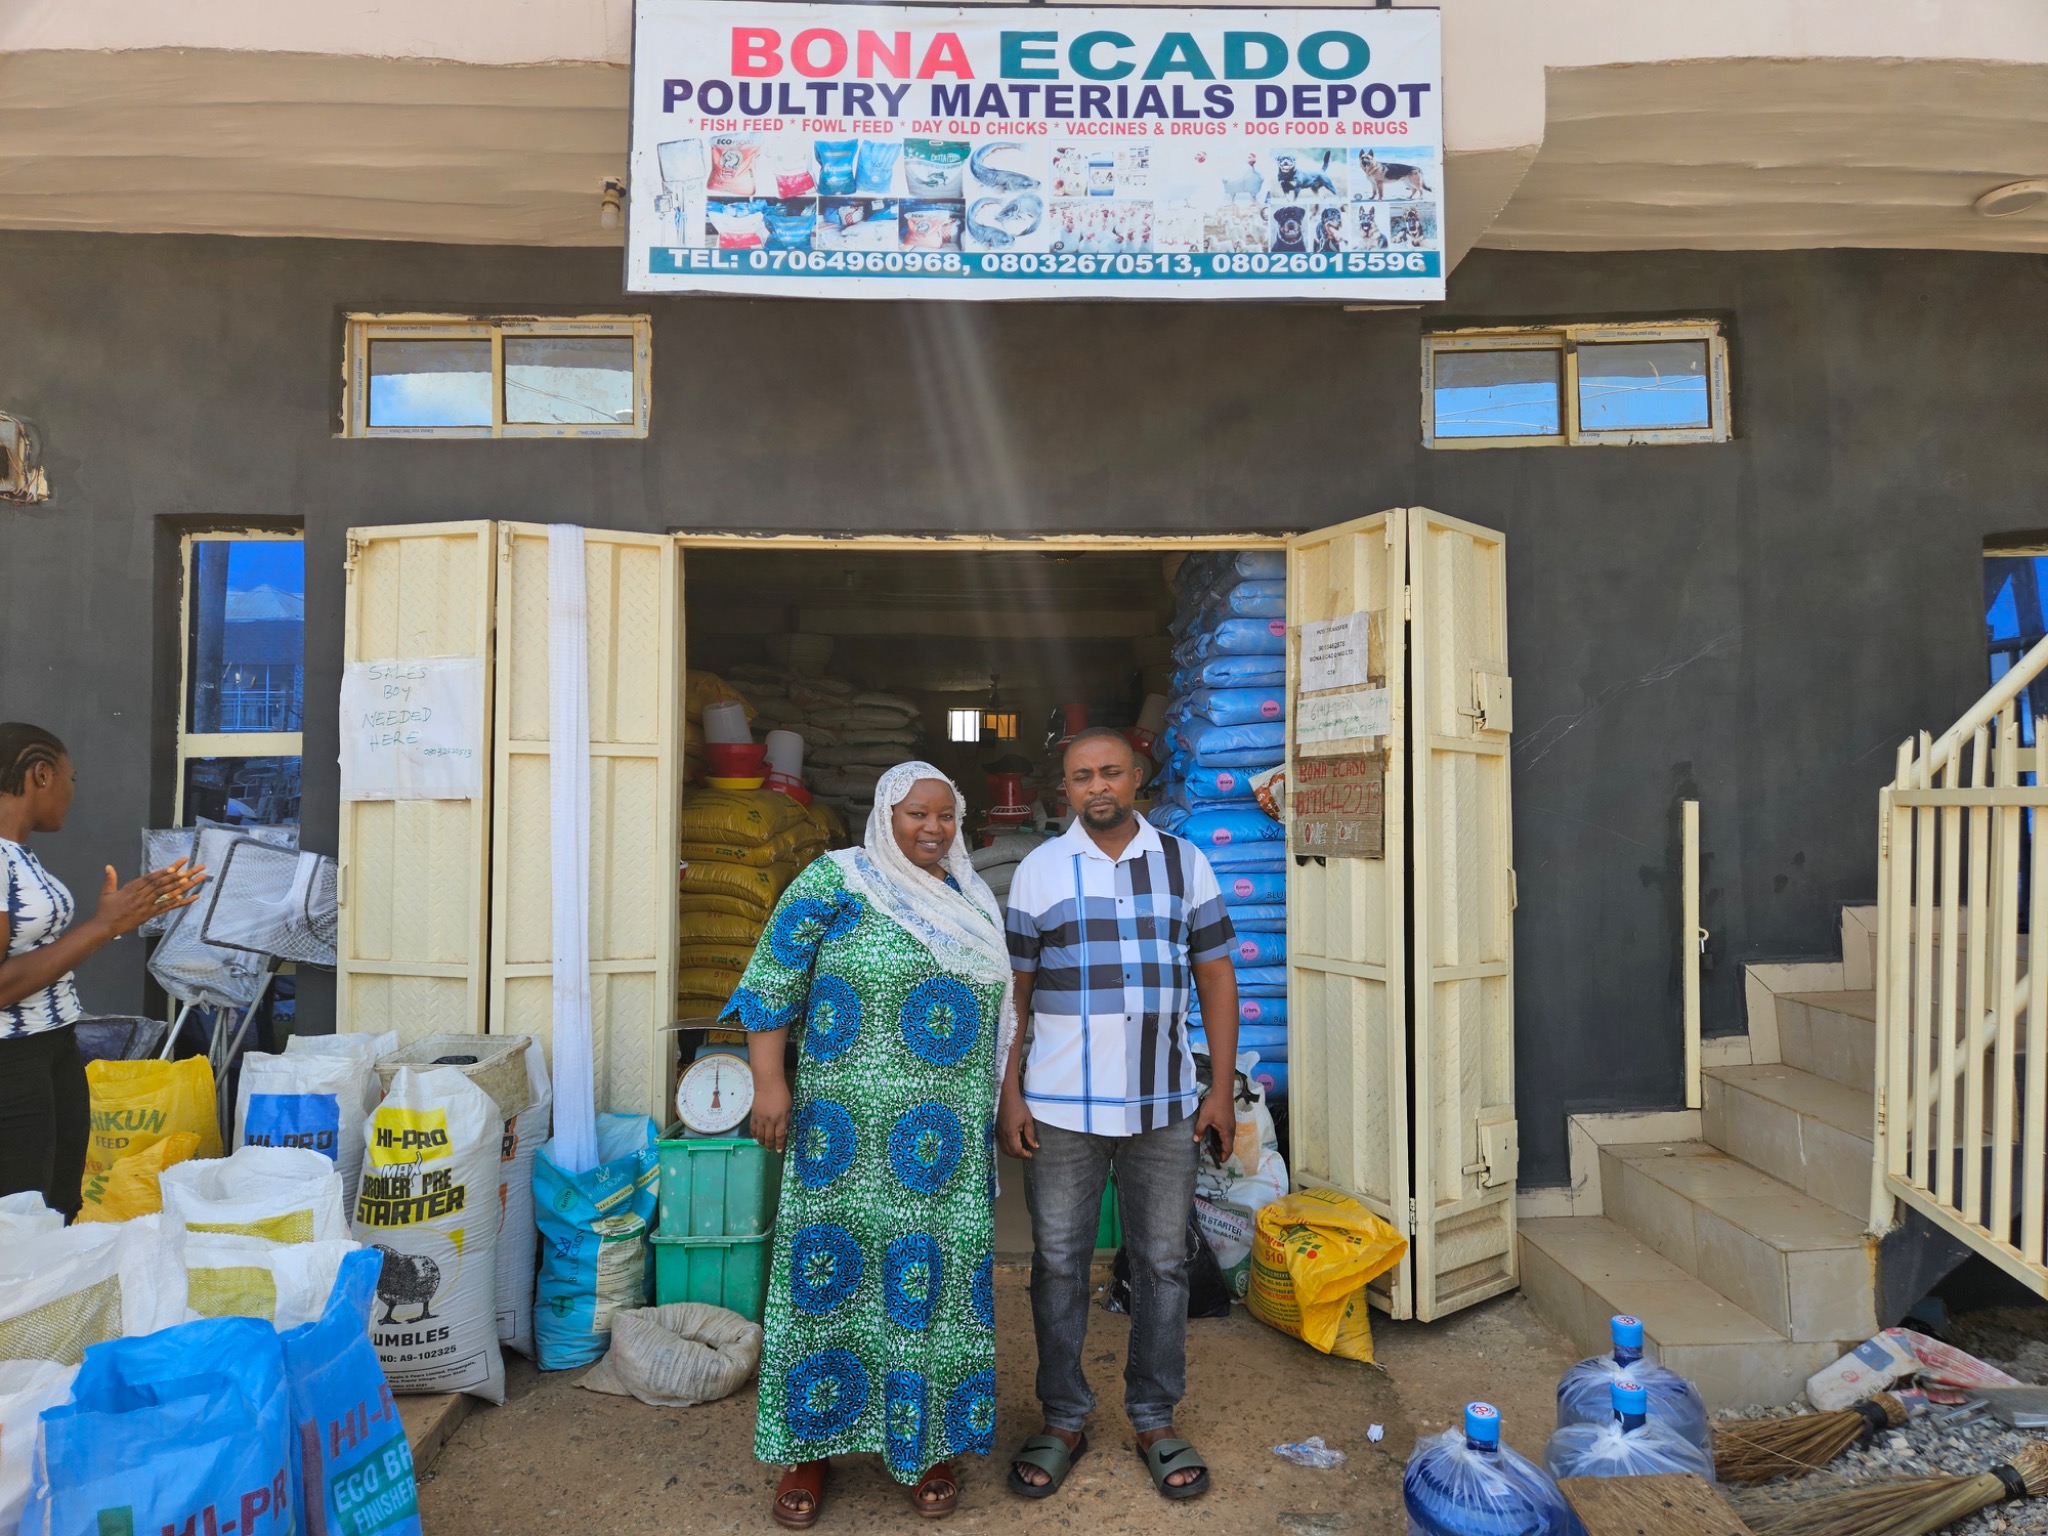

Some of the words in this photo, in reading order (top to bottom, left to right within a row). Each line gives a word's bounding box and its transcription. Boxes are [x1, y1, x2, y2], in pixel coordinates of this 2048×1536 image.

[732, 27, 975, 79] BONA
[1000, 30, 1370, 80] ECADO
[662, 79, 911, 117] POULTRY
[931, 83, 1235, 119] MATERIALS
[1255, 82, 1431, 118] DEPOT
[700, 118, 737, 131] FISH
[743, 118, 783, 131] FEED
[802, 119, 847, 133] FOWL
[853, 120, 894, 134] FEED
[912, 120, 942, 134] DAY
[949, 120, 981, 135] OLD
[986, 121, 1047, 135] CHICKS
[1067, 121, 1148, 135] VACCINES
[1154, 122, 1165, 135] &
[1170, 121, 1227, 135] DRUGS
[1245, 121, 1279, 135] DOG
[1285, 121, 1329, 135] FOOD
[1335, 121, 1346, 135] &
[1352, 121, 1409, 135] DRUGS
[669, 247, 738, 269] TEL:
[749, 249, 971, 277] 07064960968,
[981, 252, 1201, 278] 08032670513,
[1212, 252, 1426, 273] 08026015596
[368, 664, 428, 681] SALES
[383, 685, 411, 702] BOY
[362, 707, 432, 728] NEEDED
[369, 731, 420, 752] HERE
[1299, 760, 1327, 783] BONA
[1332, 759, 1366, 778] ECADO
[90, 1109, 168, 1134] HIKUN
[95, 1136, 130, 1150] FEED
[248, 1129, 333, 1150] HIPRO
[376, 1127, 449, 1149] HI-PRO
[381, 1151, 423, 1180] MAX
[363, 1174, 411, 1200] BROILER
[422, 1168, 453, 1195] PRE
[356, 1185, 466, 1227] STARTER
[1208, 1217, 1242, 1237] STARTER
[1265, 1249, 1284, 1265] 510
[373, 1326, 450, 1347] UMBLES
[380, 1354, 397, 1363] NO:
[400, 1345, 457, 1363] A9-102325
[333, 1463, 379, 1514] ECO
[353, 1476, 417, 1534] FINISHER
